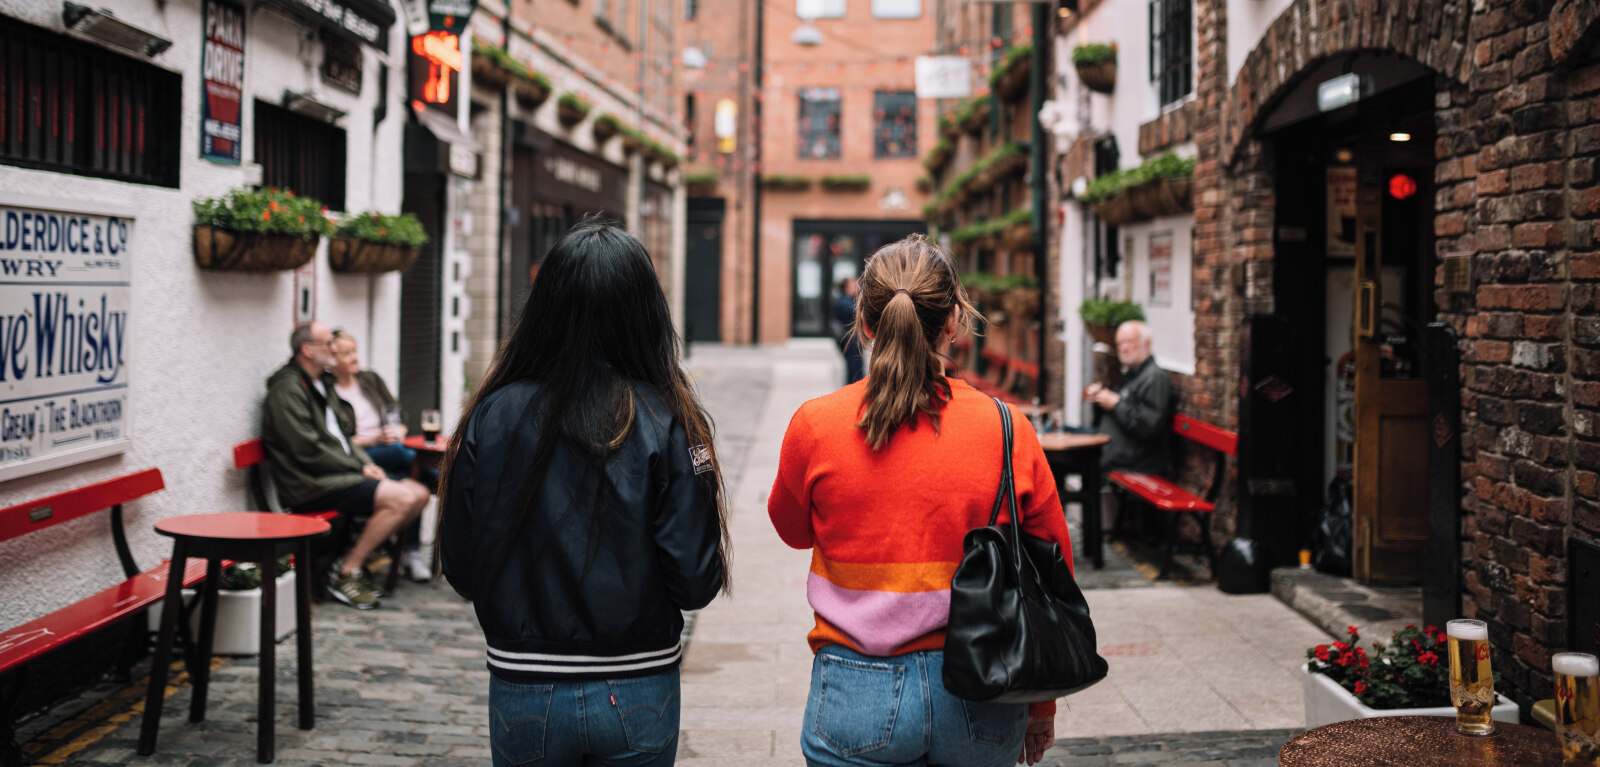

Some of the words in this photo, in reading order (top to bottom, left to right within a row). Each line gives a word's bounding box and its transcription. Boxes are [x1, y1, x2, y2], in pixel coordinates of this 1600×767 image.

[204, 42, 242, 90] DRIVE
[94, 224, 103, 254] &
[0, 259, 63, 277] WRY
[32, 292, 127, 384] Whisky
